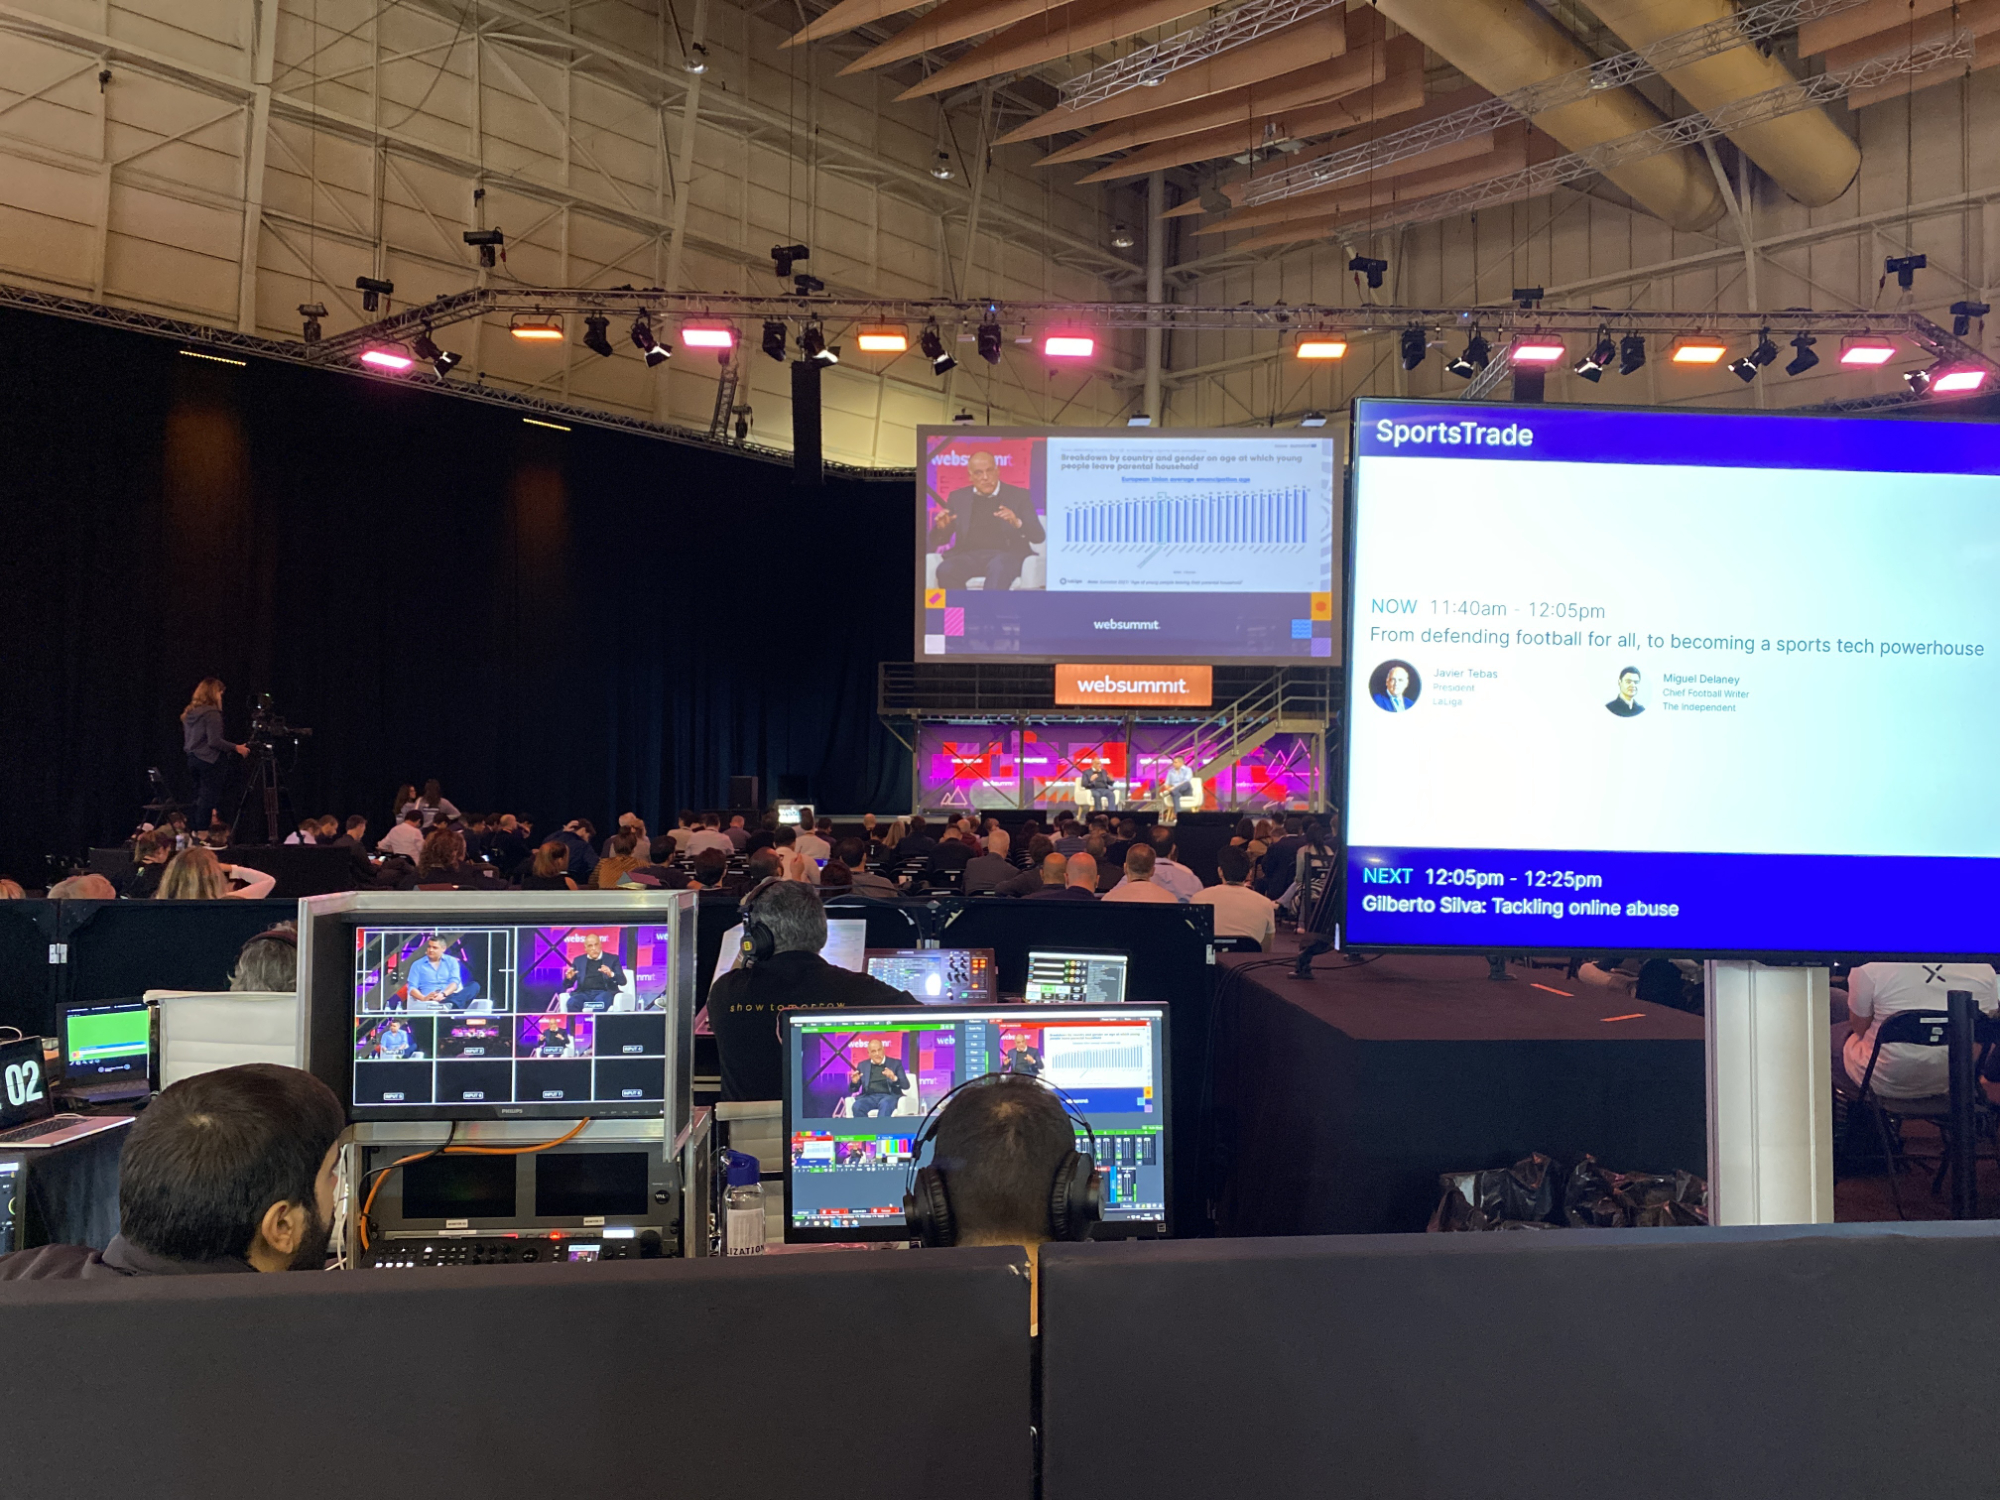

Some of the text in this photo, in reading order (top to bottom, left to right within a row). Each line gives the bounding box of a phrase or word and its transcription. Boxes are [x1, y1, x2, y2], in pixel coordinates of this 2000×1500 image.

[1376, 419, 1534, 448] SportsTrade
[1372, 599, 1418, 614] NOW
[1431, 599, 1507, 616] 11:40am
[1529, 601, 1605, 622] 12:05pm
[1370, 627, 1985, 657] From defending football for all, to becoming a sports tech powerhouse
[1433, 668, 1498, 679] Javier Tebas
[1663, 673, 1740, 686] Miguel Delaney
[1433, 682, 1475, 692] President
[1662, 688, 1750, 699] Chief Football Writer
[1663, 701, 1736, 712] The Independent
[1363, 868, 1413, 884] NEXT
[1425, 868, 1504, 889] 12:05pm
[1524, 870, 1603, 891] 12:25pm
[1362, 895, 1680, 918] Gilberto Silva: Tackling online abuse
[730, 1003, 764, 1013] show
